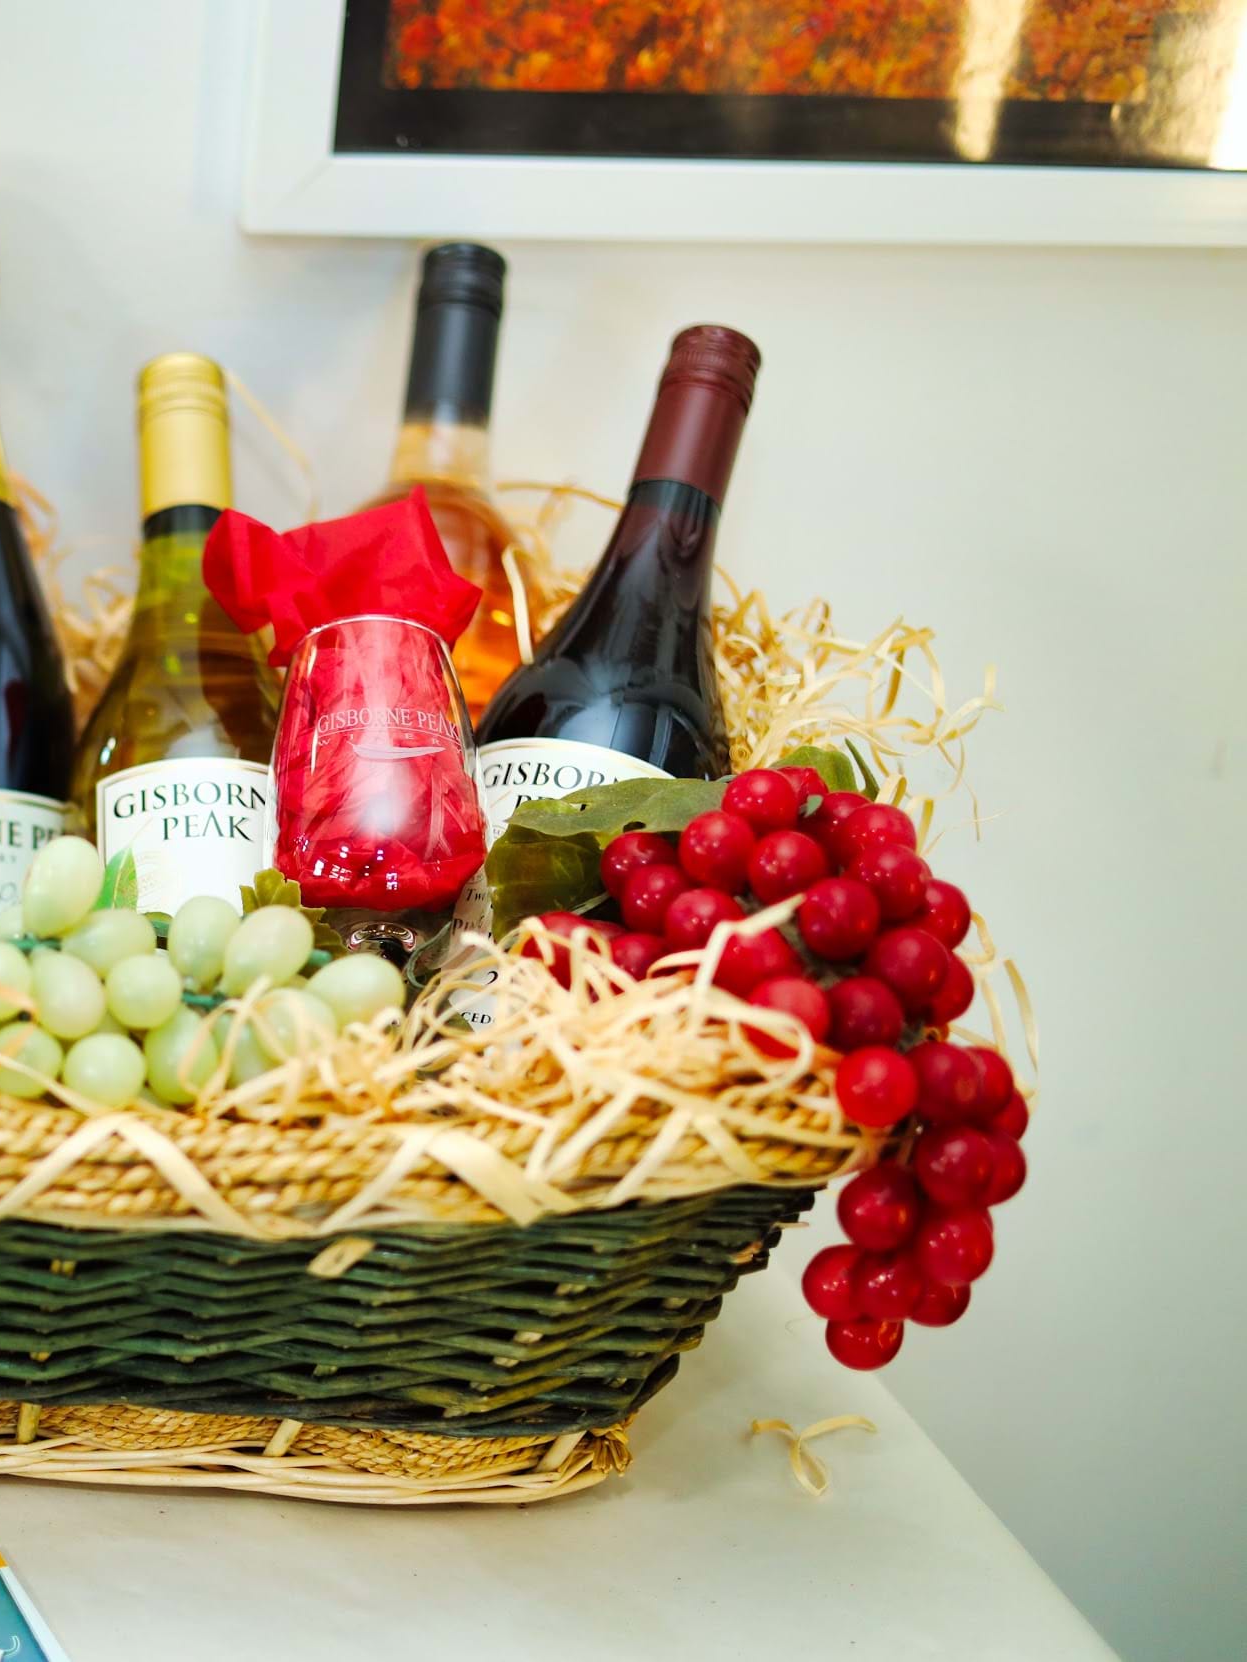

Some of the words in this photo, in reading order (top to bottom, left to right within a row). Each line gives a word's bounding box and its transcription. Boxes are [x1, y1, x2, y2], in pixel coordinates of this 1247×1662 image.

[317, 707, 412, 733] GISBORNE
[318, 732, 462, 754] WIERY
[162, 810, 253, 842] PEAK
